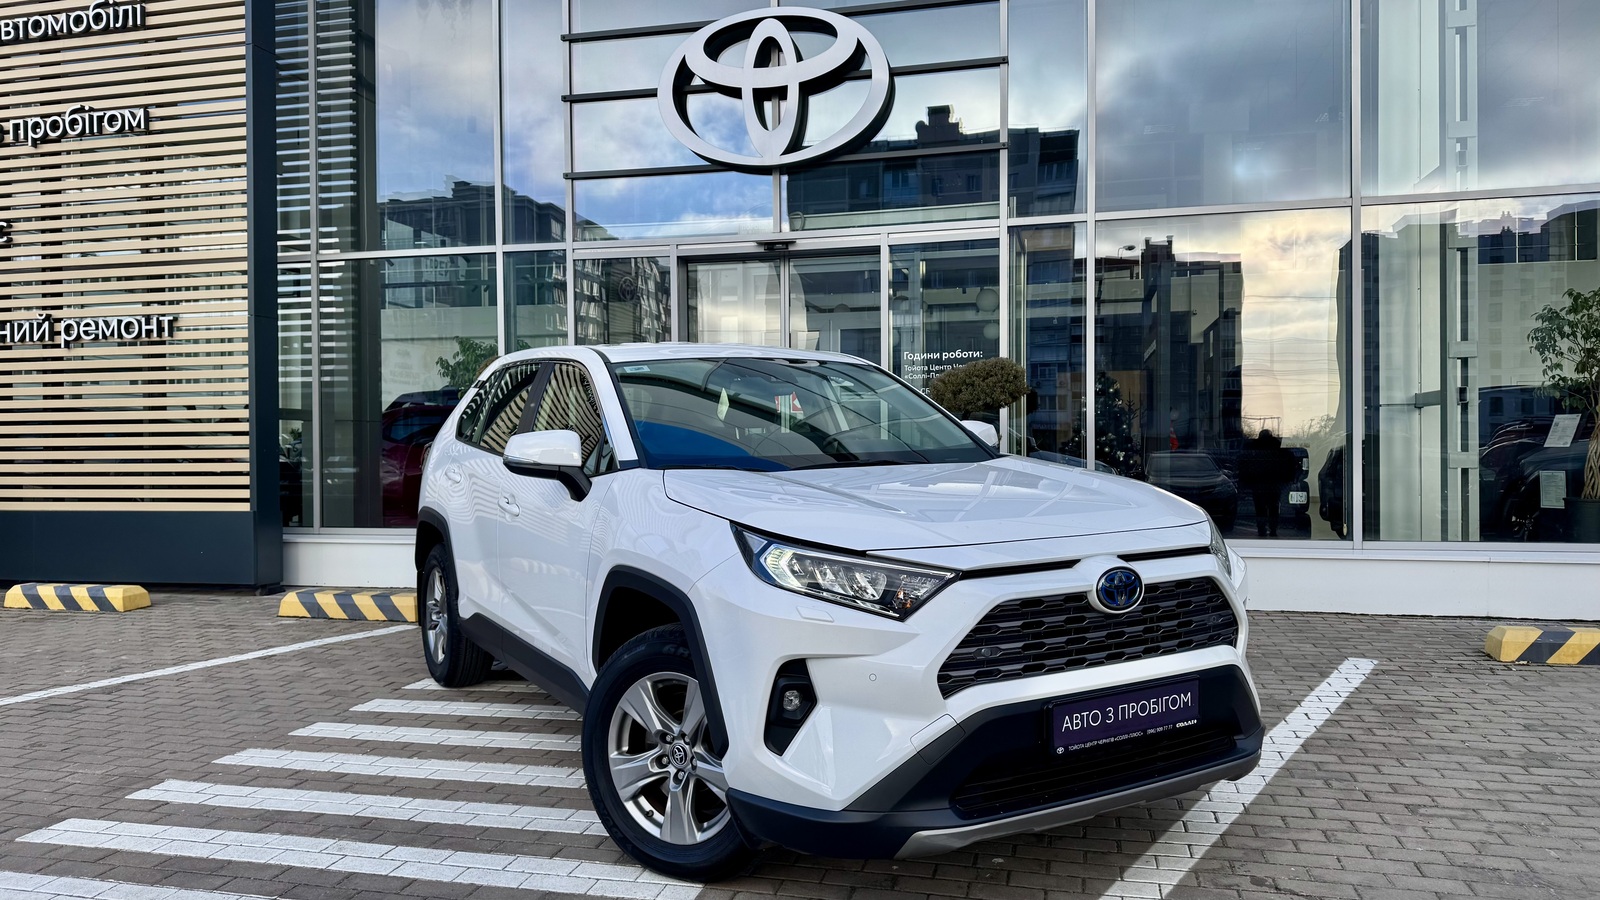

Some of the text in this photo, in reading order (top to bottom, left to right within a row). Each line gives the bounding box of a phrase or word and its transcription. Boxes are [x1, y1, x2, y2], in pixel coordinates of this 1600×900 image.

[9, 104, 146, 147] пробігом
[61, 316, 174, 348] ремонт
[903, 349, 983, 360] Години роботи:
[904, 364, 928, 372] Тойота
[1062, 709, 1102, 732] АВТО
[1118, 692, 1192, 721] ПРОБІГОМ
